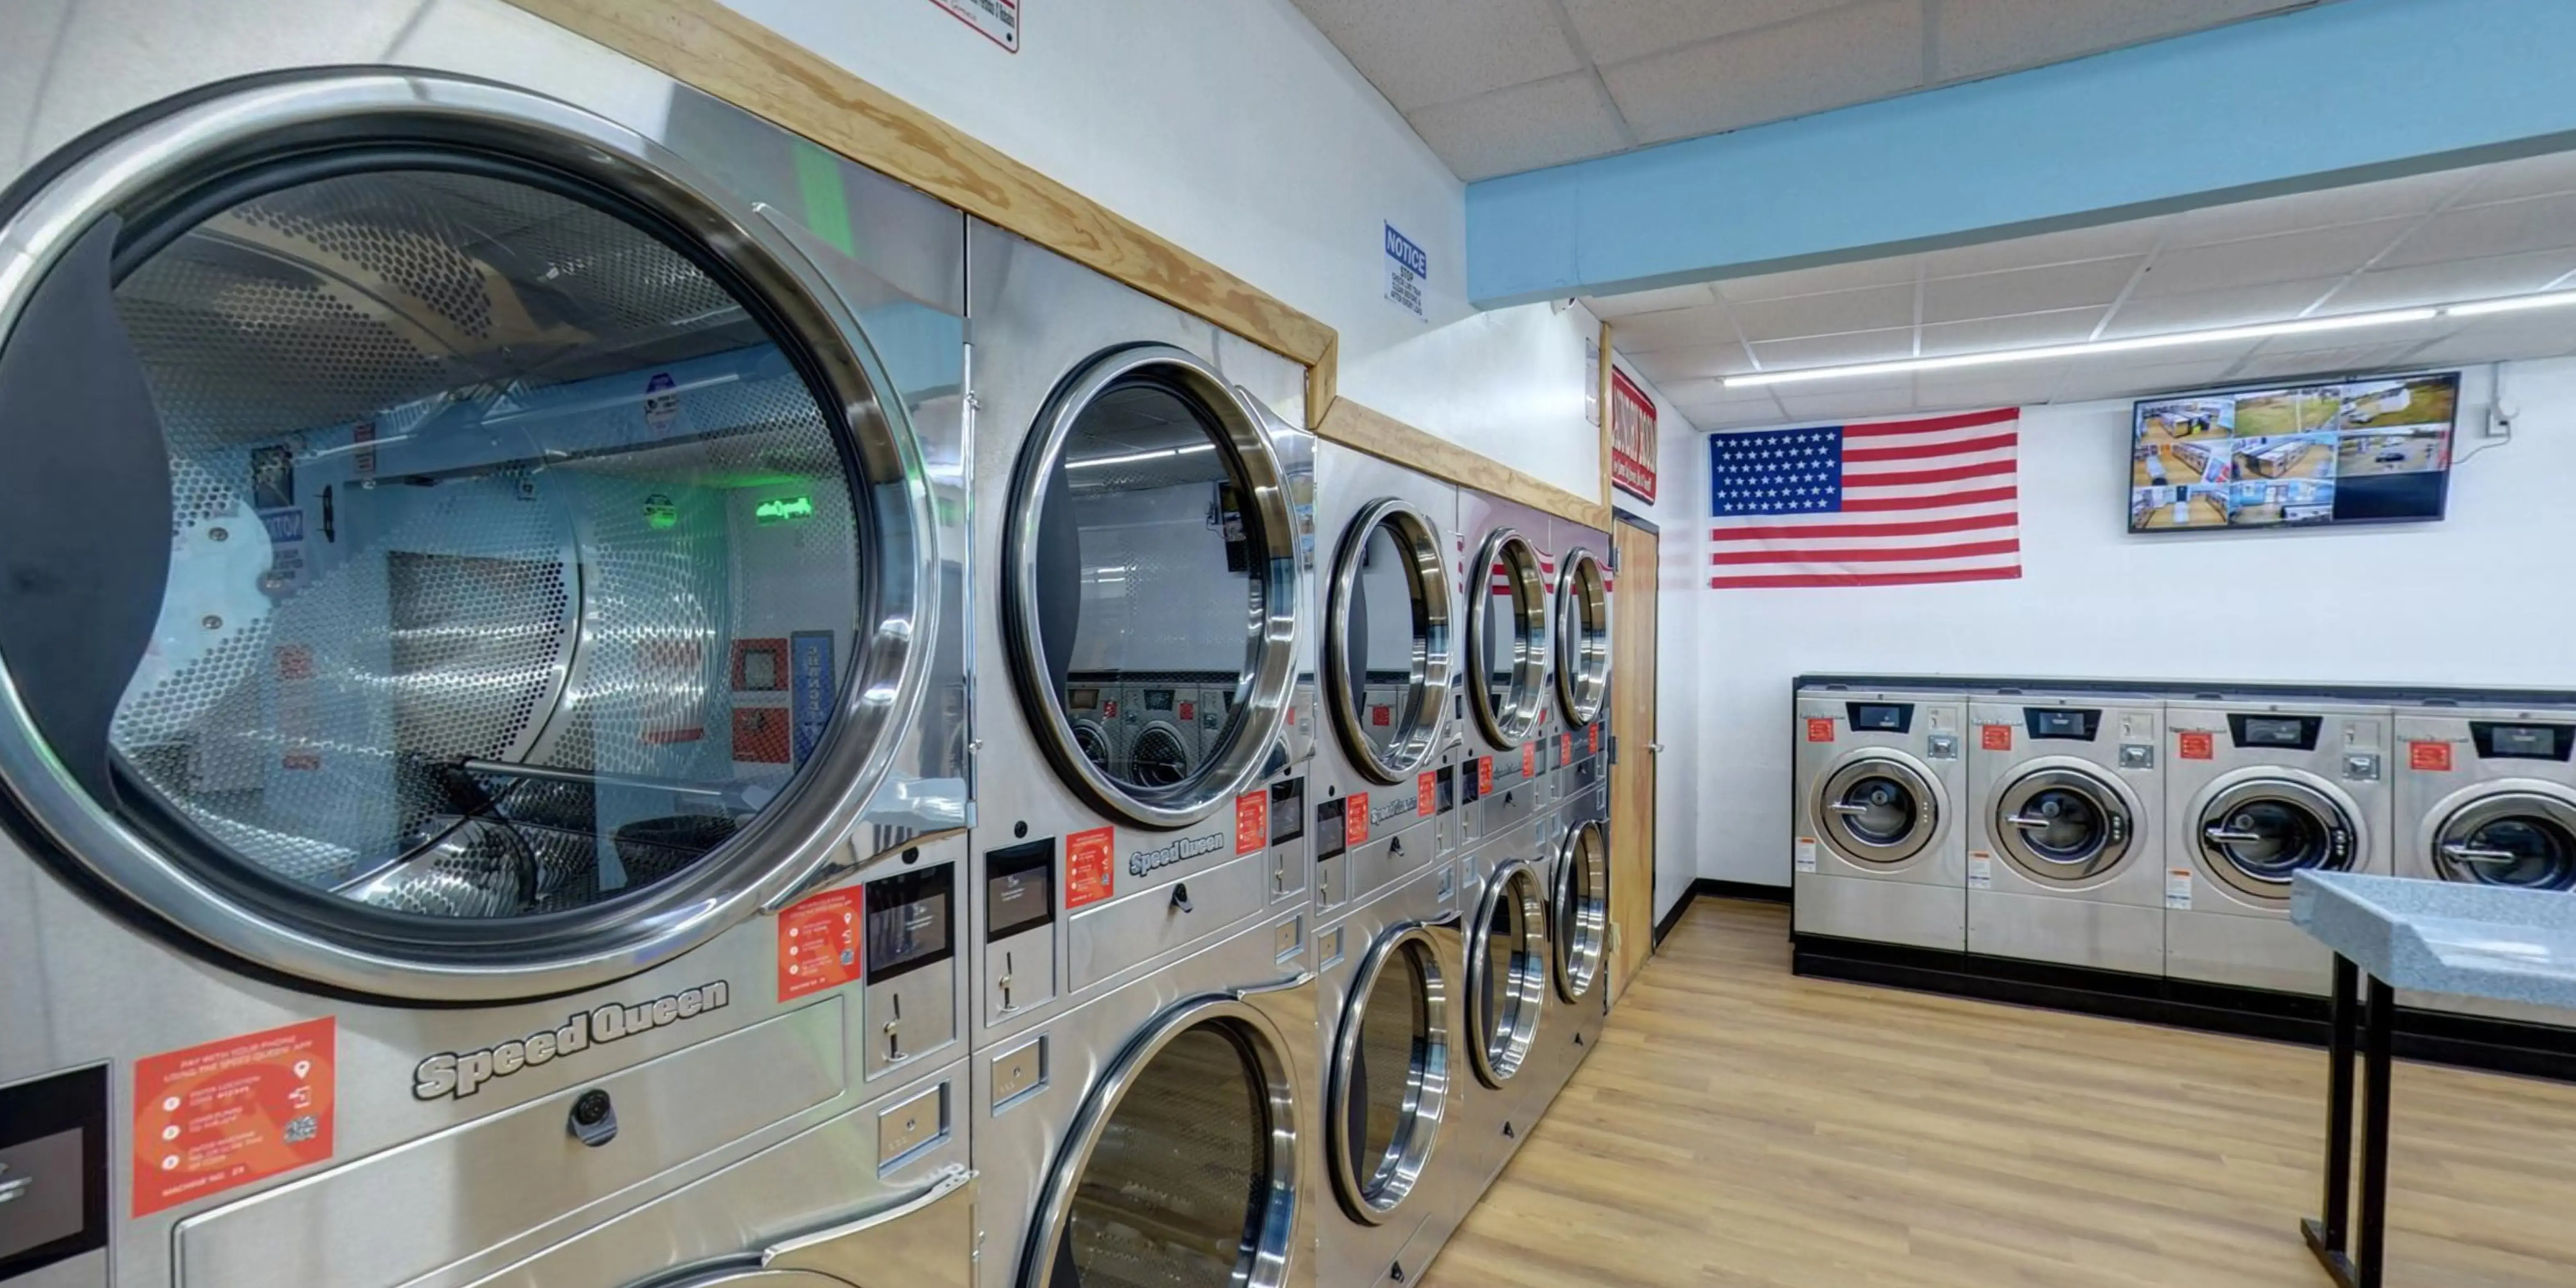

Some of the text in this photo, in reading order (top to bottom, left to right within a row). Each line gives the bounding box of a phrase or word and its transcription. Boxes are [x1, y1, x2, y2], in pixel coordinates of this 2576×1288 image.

[1387, 229, 1425, 274] NOTICE
[1130, 840, 1180, 877] Speed
[1179, 832, 1224, 860] Queen
[413, 980, 729, 1100] Speed Queen
